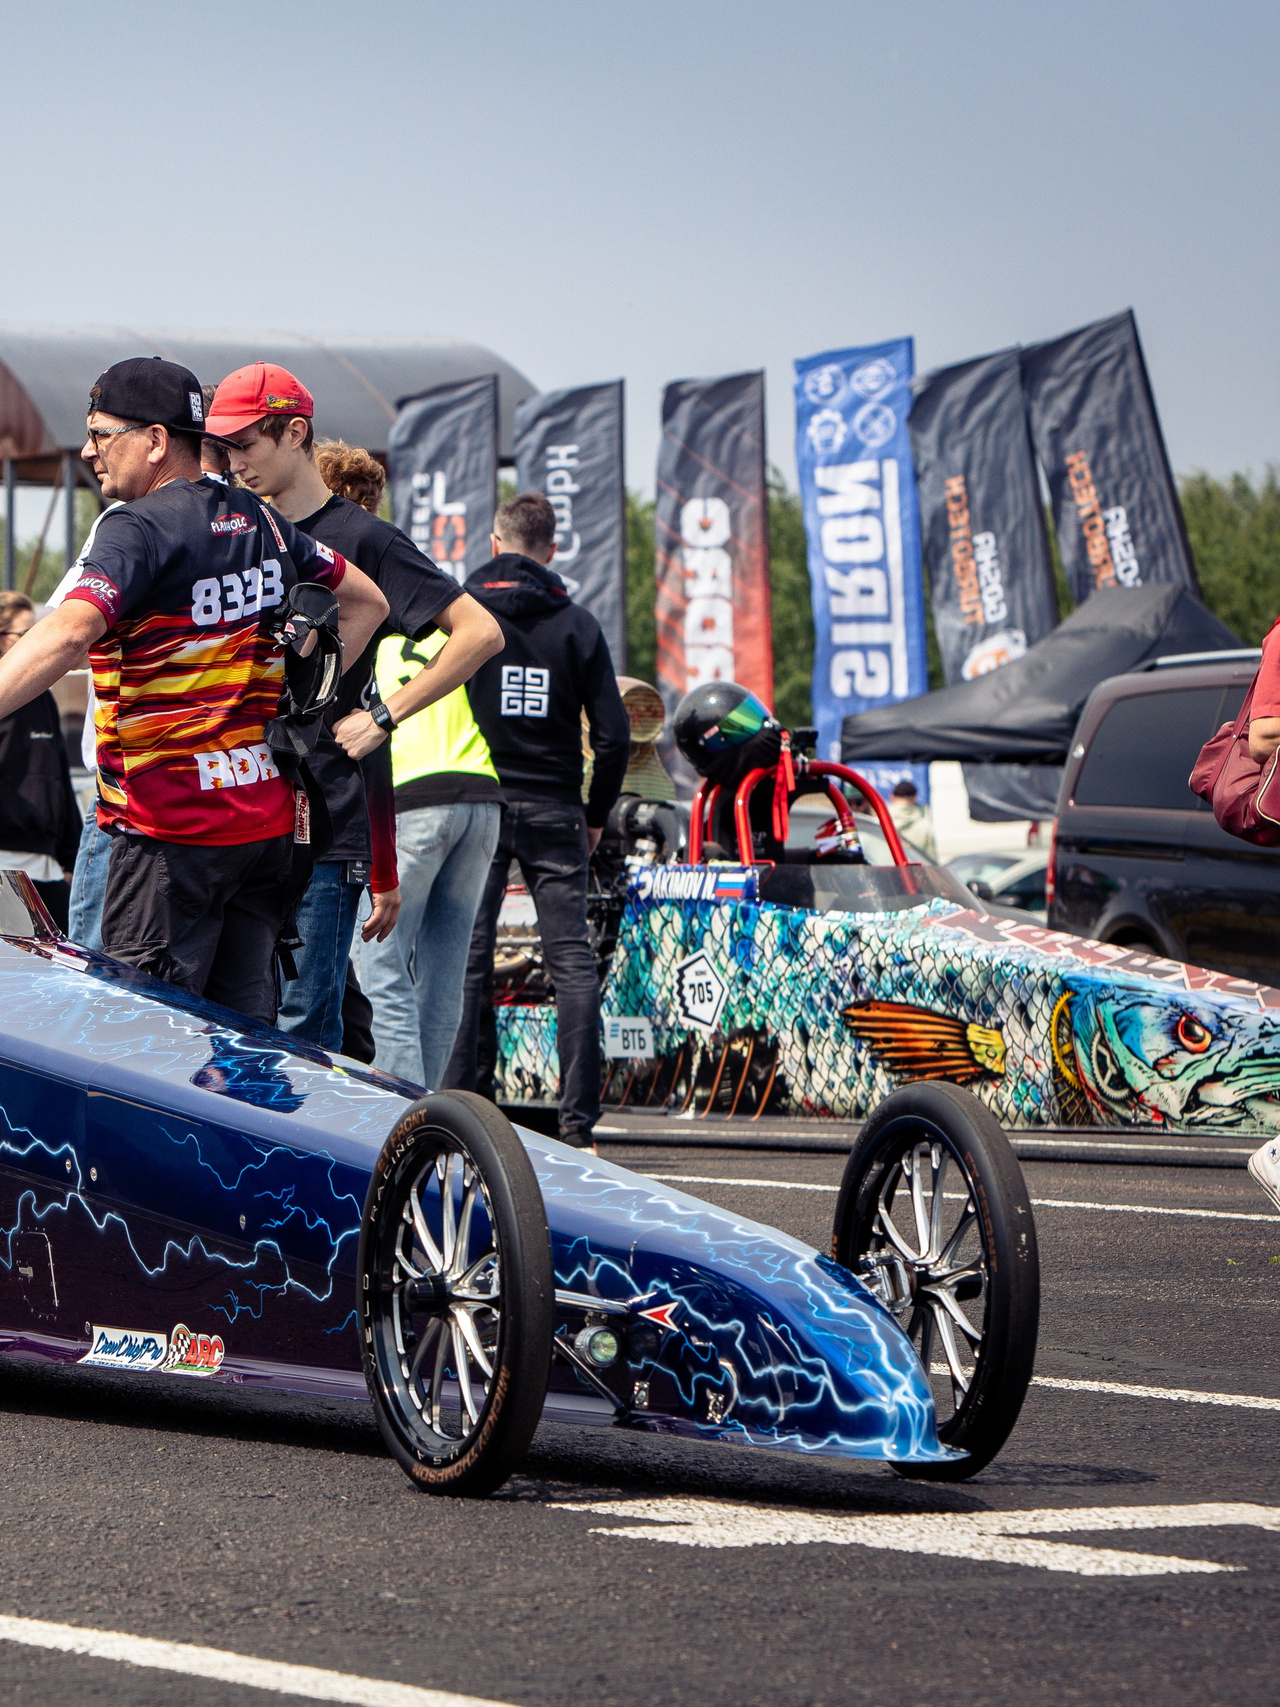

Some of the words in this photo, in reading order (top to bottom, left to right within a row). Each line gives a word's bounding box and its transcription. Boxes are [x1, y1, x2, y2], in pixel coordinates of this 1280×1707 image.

[297, 795, 307, 839] SIMPSON
[652, 869, 704, 900] AKIMOV
[689, 981, 714, 1005] 705
[622, 1029, 646, 1050] ВТБ
[184, 1339, 223, 1368] ARC
[412, 1447, 479, 1485] THOMPSON
